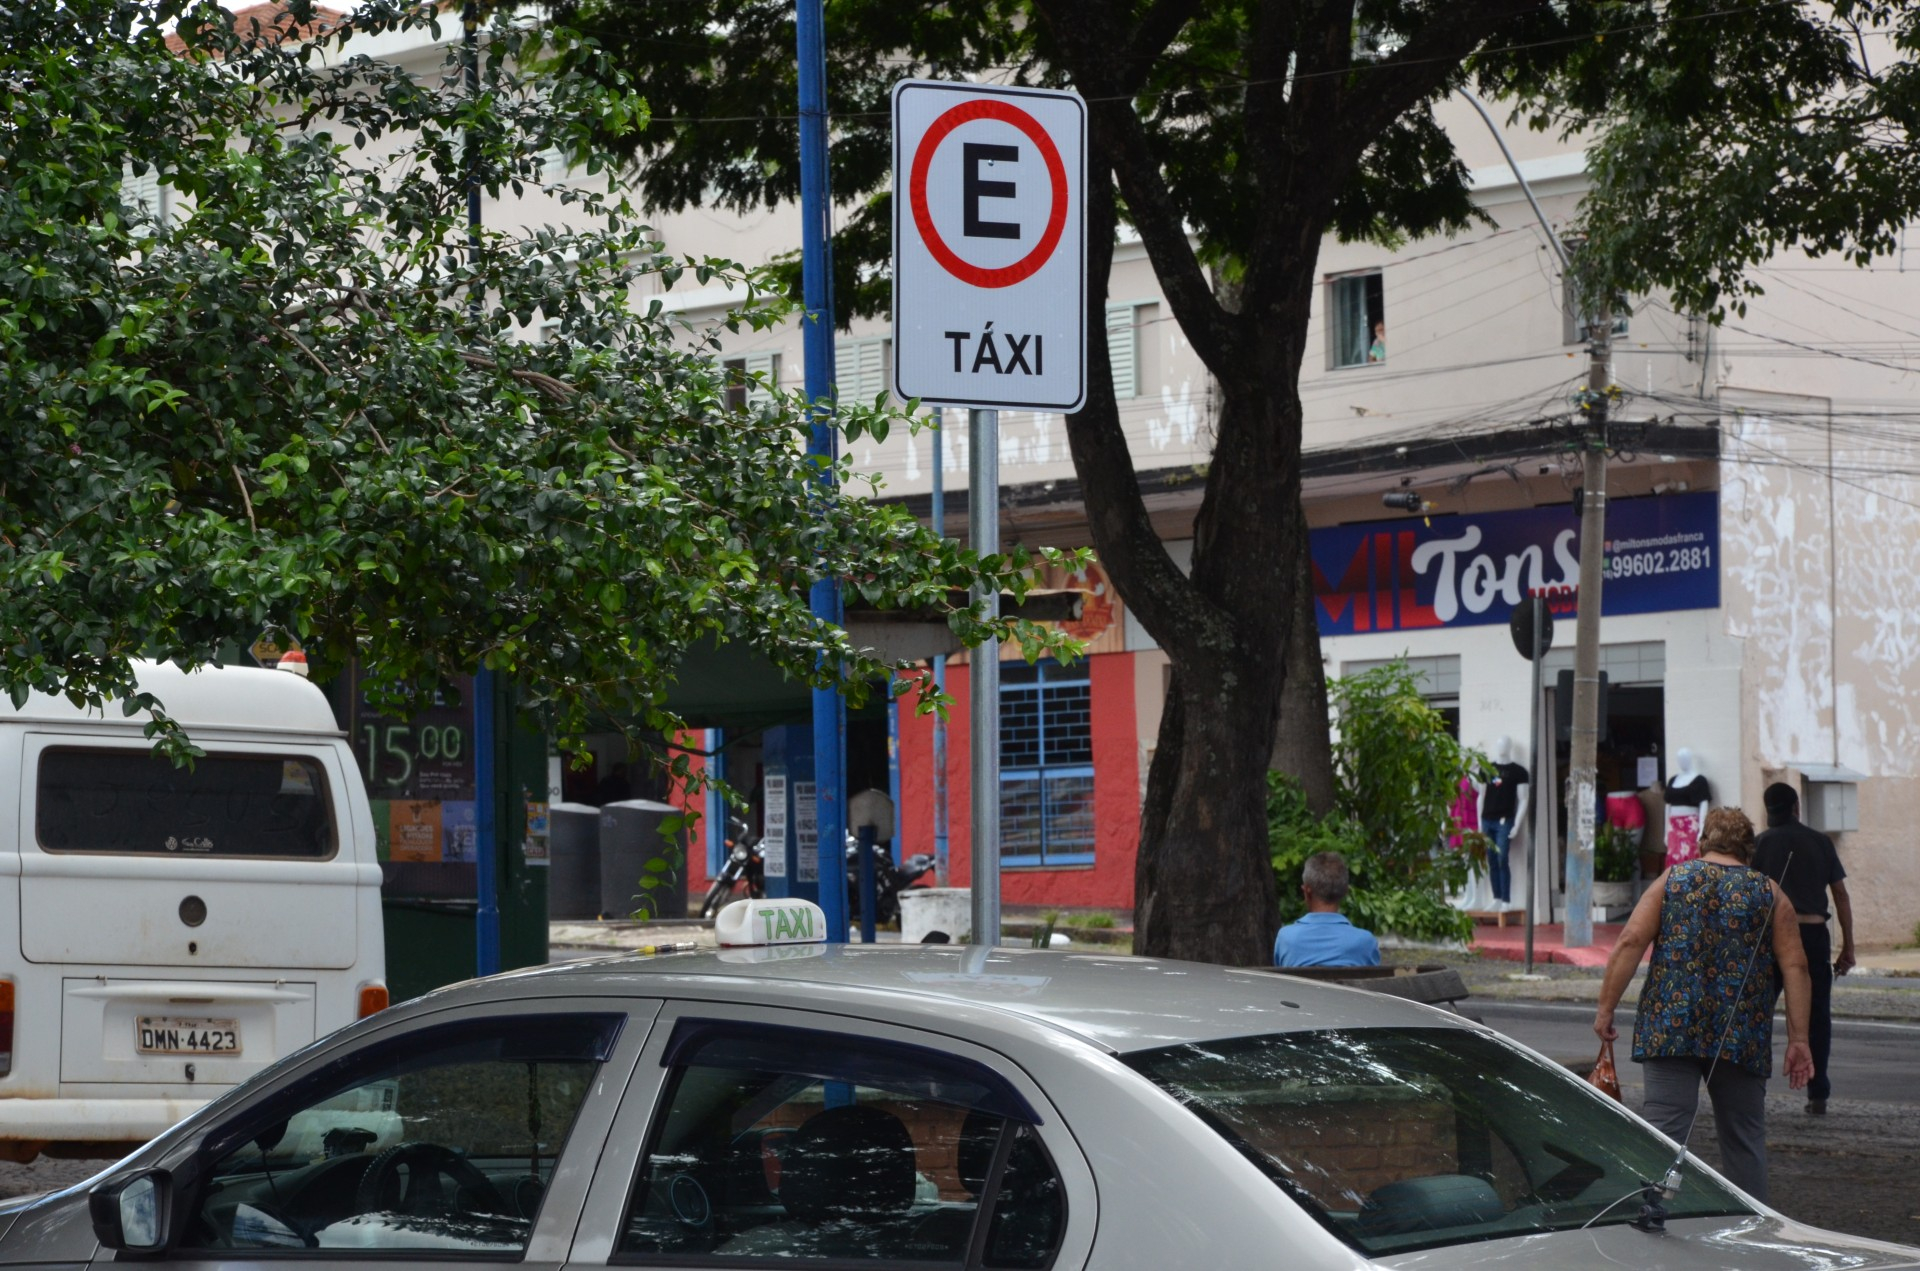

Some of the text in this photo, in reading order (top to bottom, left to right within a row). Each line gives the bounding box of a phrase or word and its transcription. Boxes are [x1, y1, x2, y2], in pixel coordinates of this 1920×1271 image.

[963, 142, 1020, 239] E
[944, 321, 1043, 376] TÁXI
[1612, 532, 1704, 553] @miltonsmodasfranca
[1612, 545, 1711, 578] 99602.2881
[758, 907, 813, 940] TAXI
